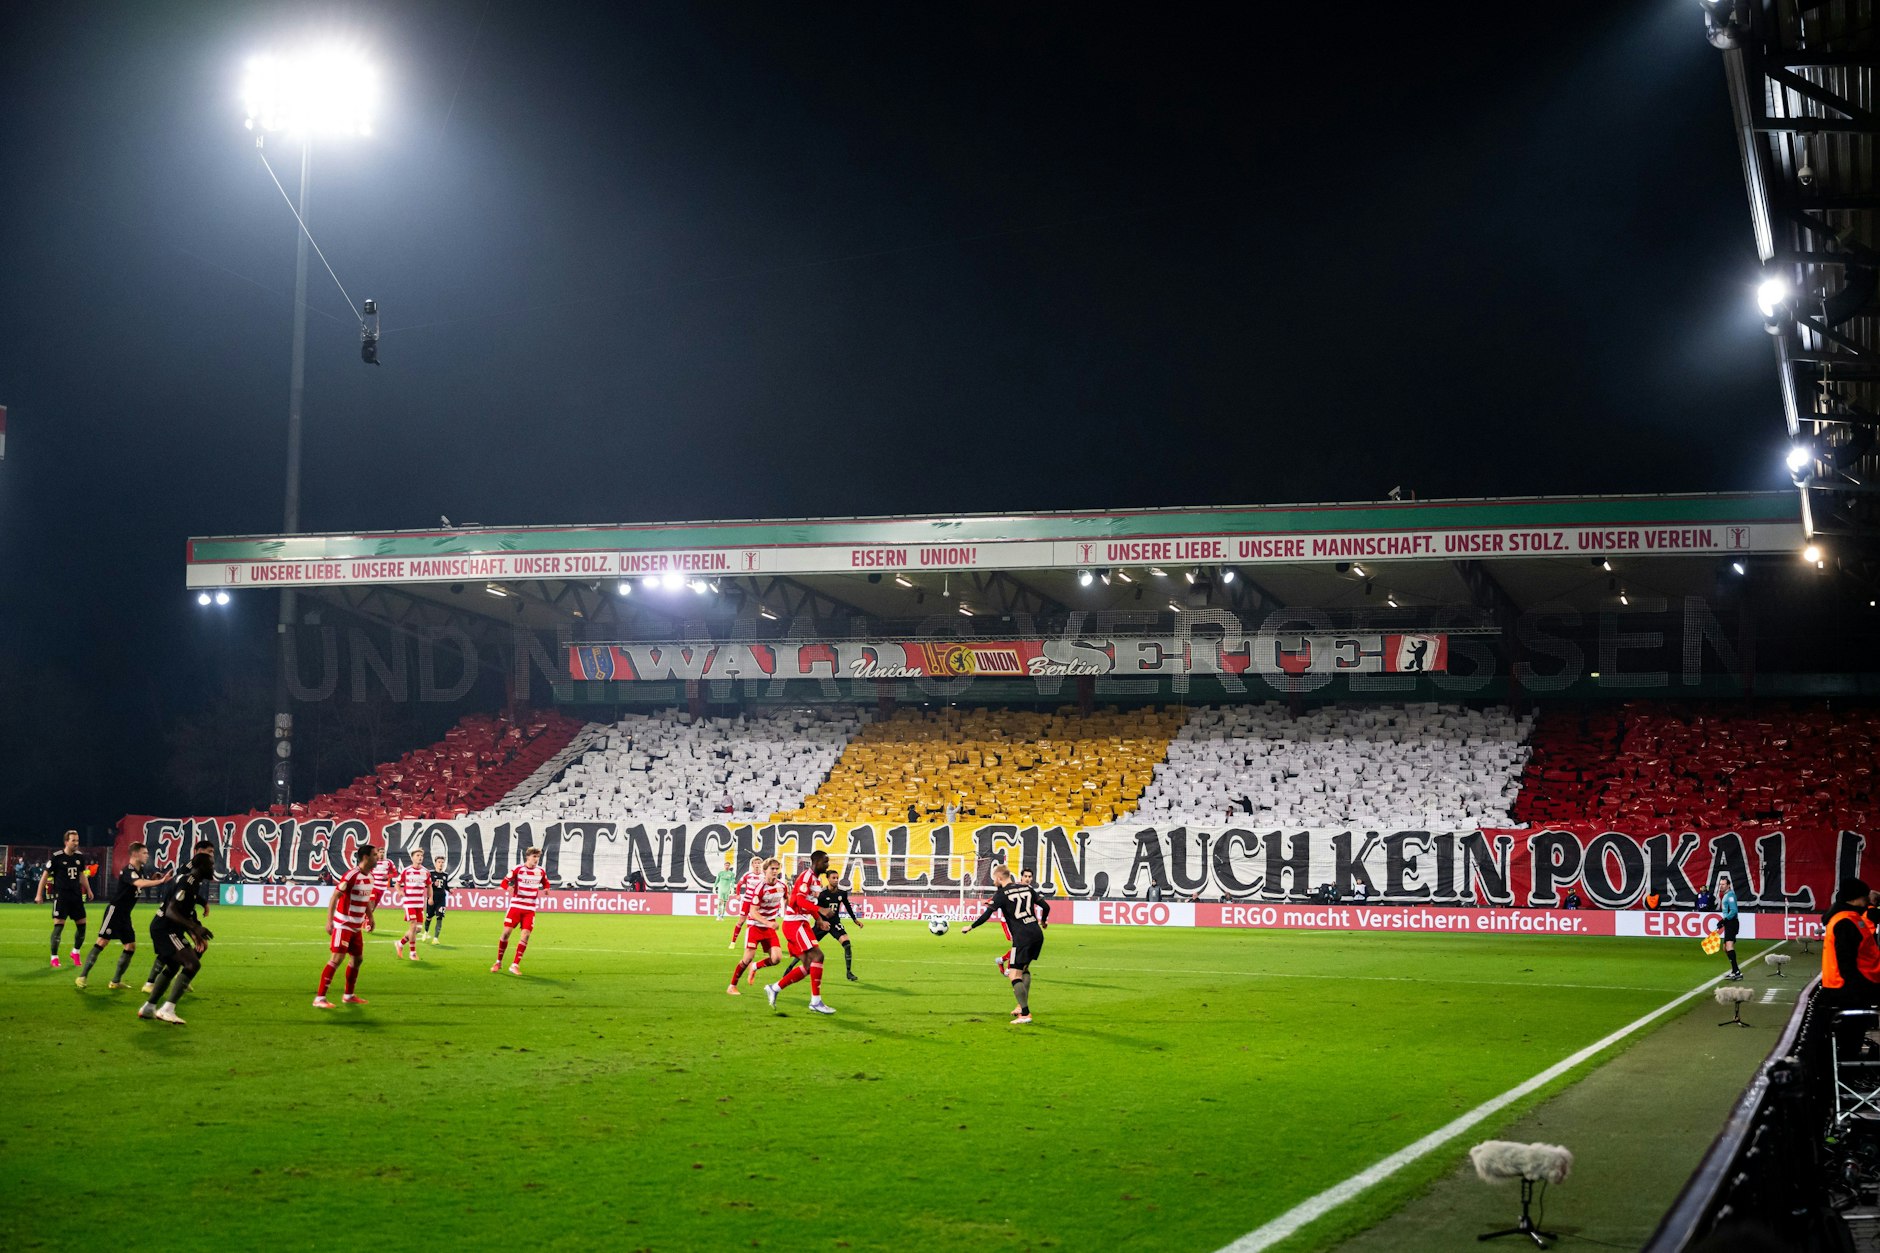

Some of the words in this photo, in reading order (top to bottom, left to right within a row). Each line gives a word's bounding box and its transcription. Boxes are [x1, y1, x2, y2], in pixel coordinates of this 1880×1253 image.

[851, 549, 907, 567] EISERN
[919, 547, 977, 566] UNION!
[1106, 542, 1171, 562] UNSERE
[1175, 540, 1227, 560] LIEBE.
[1238, 539, 1305, 558] UNSERE
[1312, 535, 1436, 557] MANNSCHAFT.
[1444, 533, 1504, 553] UNSER
[1508, 531, 1570, 551] STOLZ.
[1577, 530, 1643, 549] UNSER
[1646, 529, 1718, 549] VEREIN.
[251, 564, 304, 582] UNSERE
[305, 563, 345, 580] LIEBE.
[351, 561, 404, 579] UNSERE
[409, 558, 508, 578] MANNSCHAFT.
[513, 557, 561, 575] UNSER
[564, 555, 612, 573] STOLZ.
[620, 553, 668, 573] UNSER
[672, 552, 730, 570] VEREIN.
[283, 623, 478, 702] UND
[848, 657, 923, 679] Union
[1027, 655, 1102, 677] Berlin
[974, 651, 1019, 672] UNION
[144, 817, 236, 883] EIN
[240, 817, 370, 886] SIEG
[383, 819, 617, 890] KOMMT
[624, 821, 836, 893] NICHT
[1122, 826, 1312, 901] AUCH
[1331, 828, 1515, 908] KEIN
[1528, 829, 1816, 911] POKAL
[263, 885, 320, 907] ERGO
[569, 892, 651, 914] einfacher.
[1007, 891, 1032, 919] 27
[1099, 901, 1170, 926] ERGO
[1221, 906, 1277, 925] ERGO
[1283, 907, 1350, 927] macht
[1356, 908, 1470, 930] Versichern
[1476, 910, 1588, 932] einfacher.
